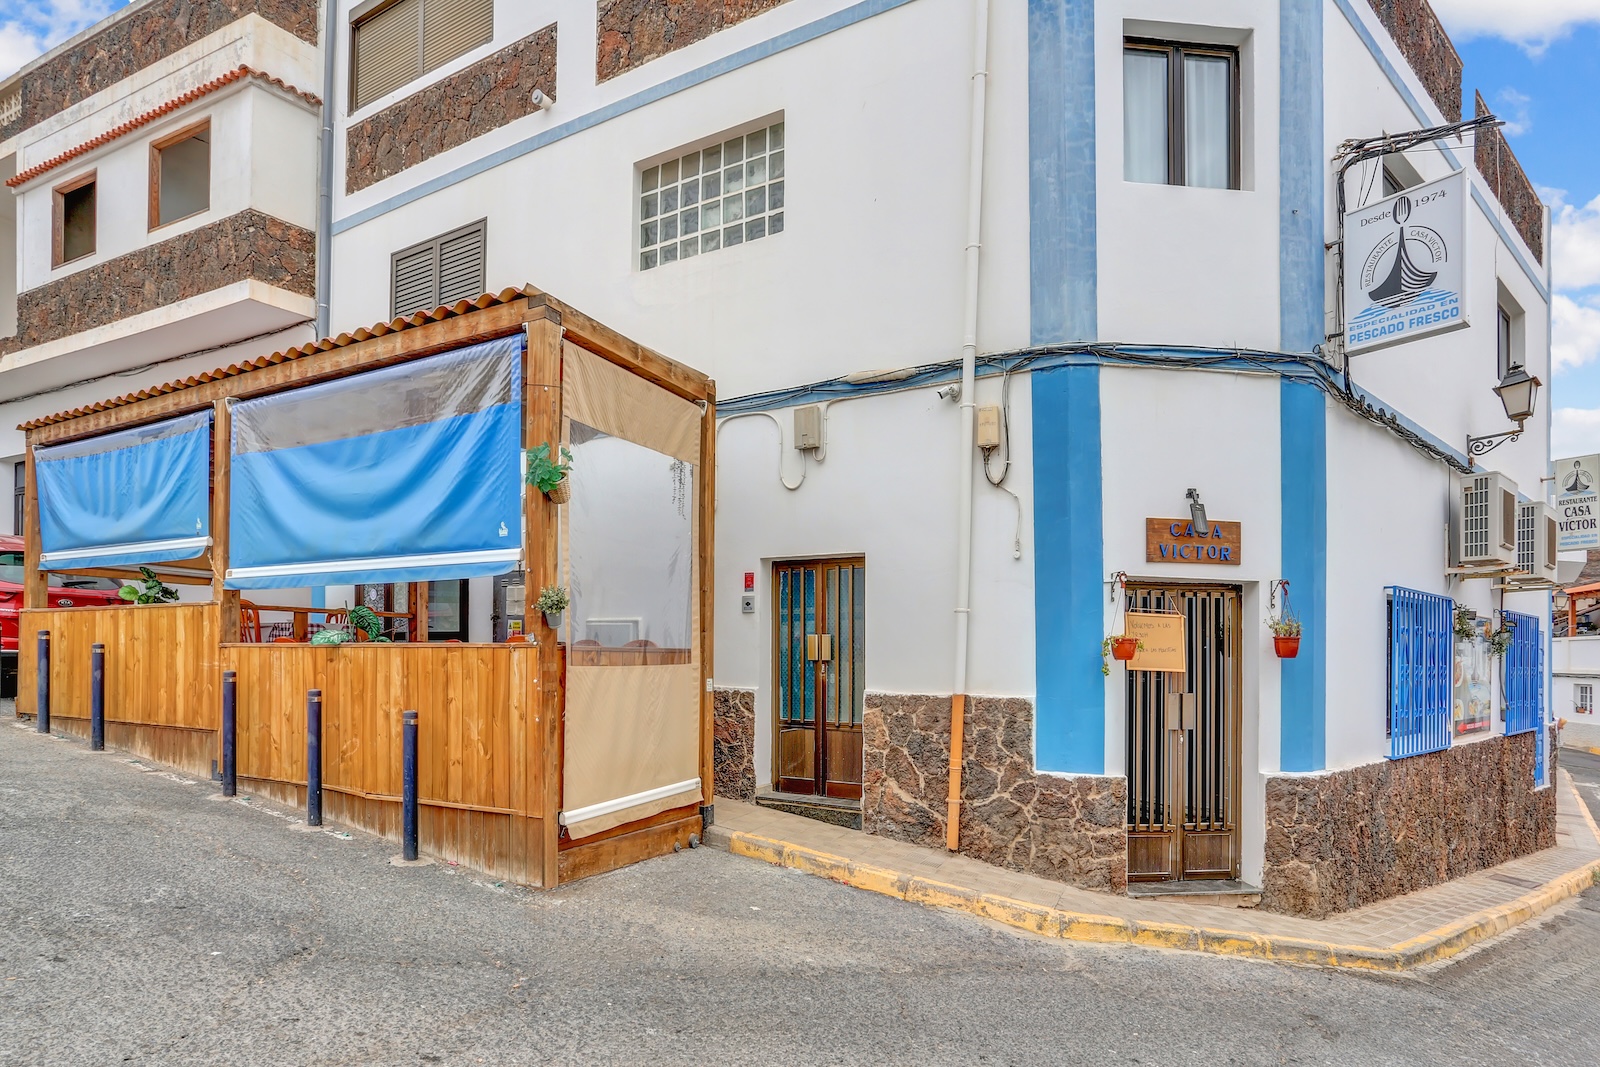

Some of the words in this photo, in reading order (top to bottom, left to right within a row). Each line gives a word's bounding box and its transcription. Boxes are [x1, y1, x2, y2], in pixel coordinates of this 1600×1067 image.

[1360, 210, 1391, 227] Desde
[1414, 189, 1447, 207] 1974
[1365, 237, 1394, 288] RESTAURANTE
[1410, 229, 1429, 240] CASA
[1427, 236, 1442, 263] VICTOR
[1349, 304, 1436, 332] ESPECIALIDAD
[1440, 297, 1459, 307] EN
[1349, 321, 1405, 344] PESCADO
[1409, 306, 1459, 329] FRESCO
[1558, 496, 1598, 507] RESTAURANTE
[1564, 505, 1591, 518] CASA
[1169, 522, 1223, 539] CAA
[1159, 543, 1231, 561] VICTOR
